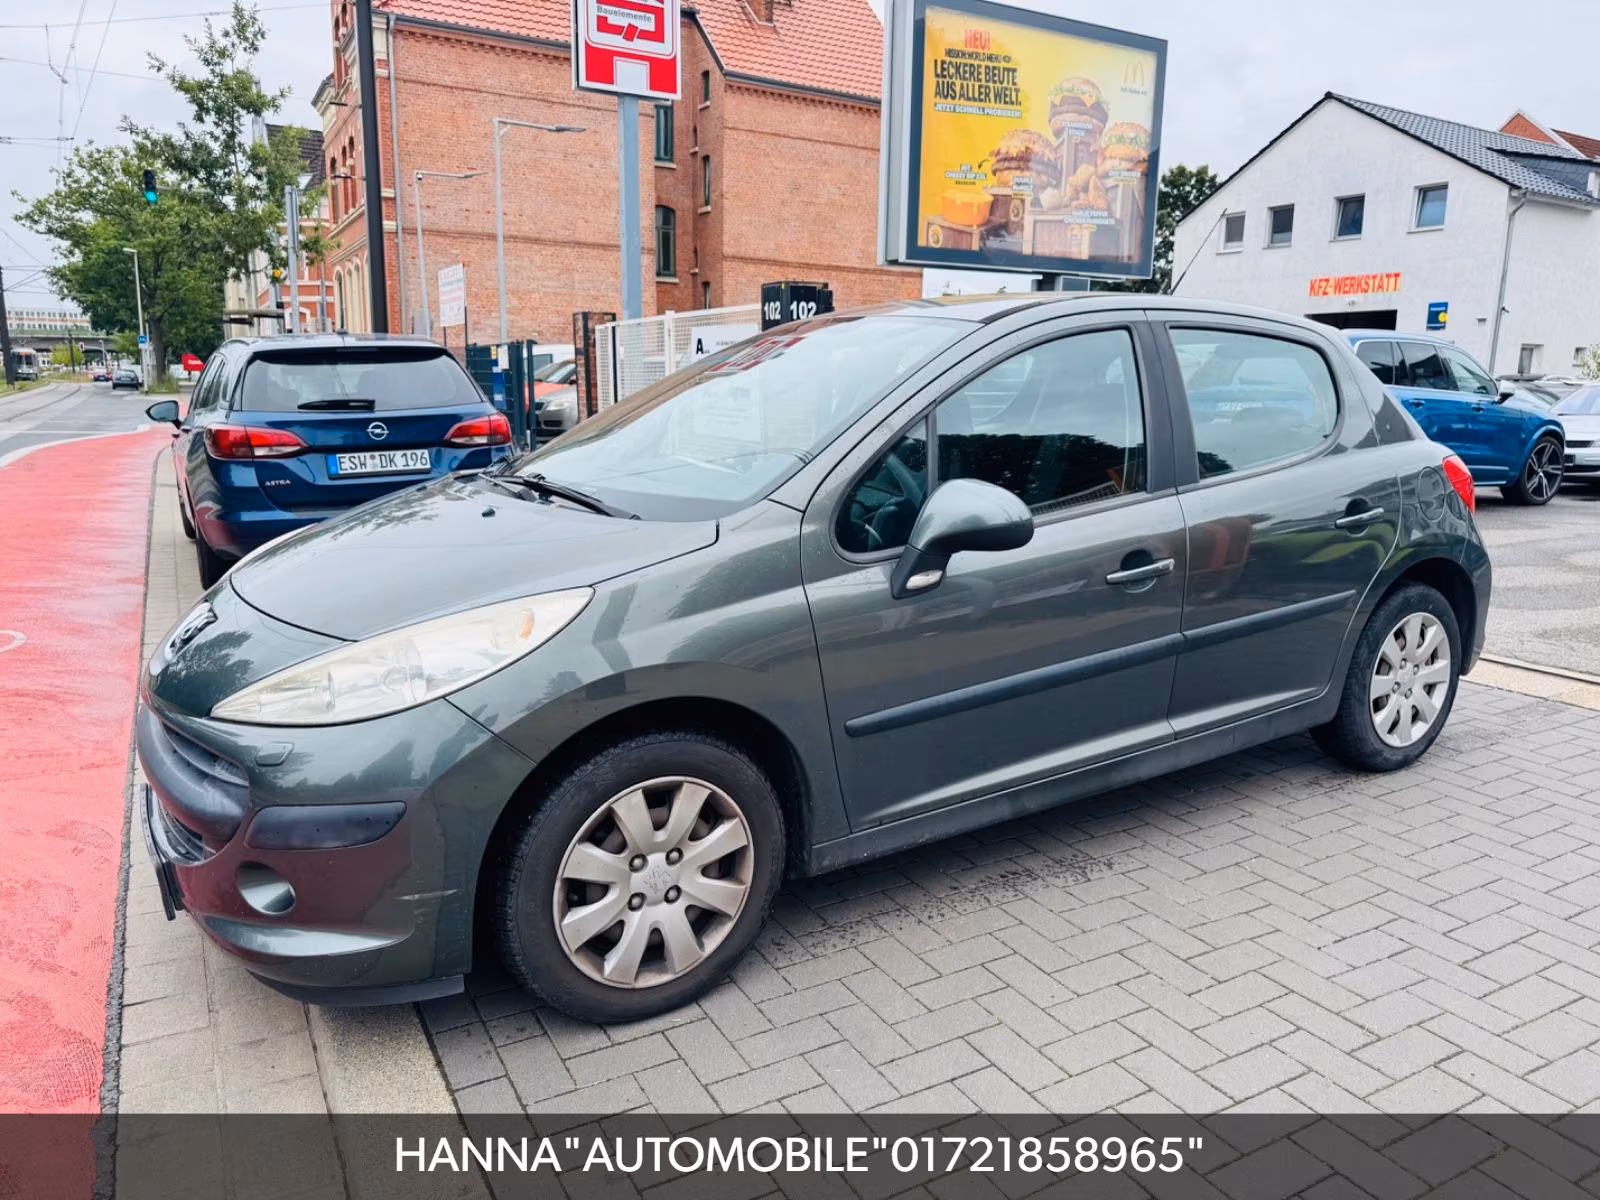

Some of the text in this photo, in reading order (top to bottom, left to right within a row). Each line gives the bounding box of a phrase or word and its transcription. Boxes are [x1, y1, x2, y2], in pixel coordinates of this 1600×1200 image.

[597, 6, 652, 22] Bauelemente
[964, 28, 990, 51] NEU!
[934, 59, 1018, 87] LECKERE BEUTE
[934, 80, 1022, 107] AUS ALLER WELT.
[1309, 272, 1401, 297] KFZ-WERKSTATT
[763, 301, 781, 320] 102
[790, 301, 817, 319] 102
[338, 454, 367, 471] ESW
[379, 453, 398, 469] DK
[401, 450, 428, 467] 196
[264, 479, 292, 487] ASTRA
